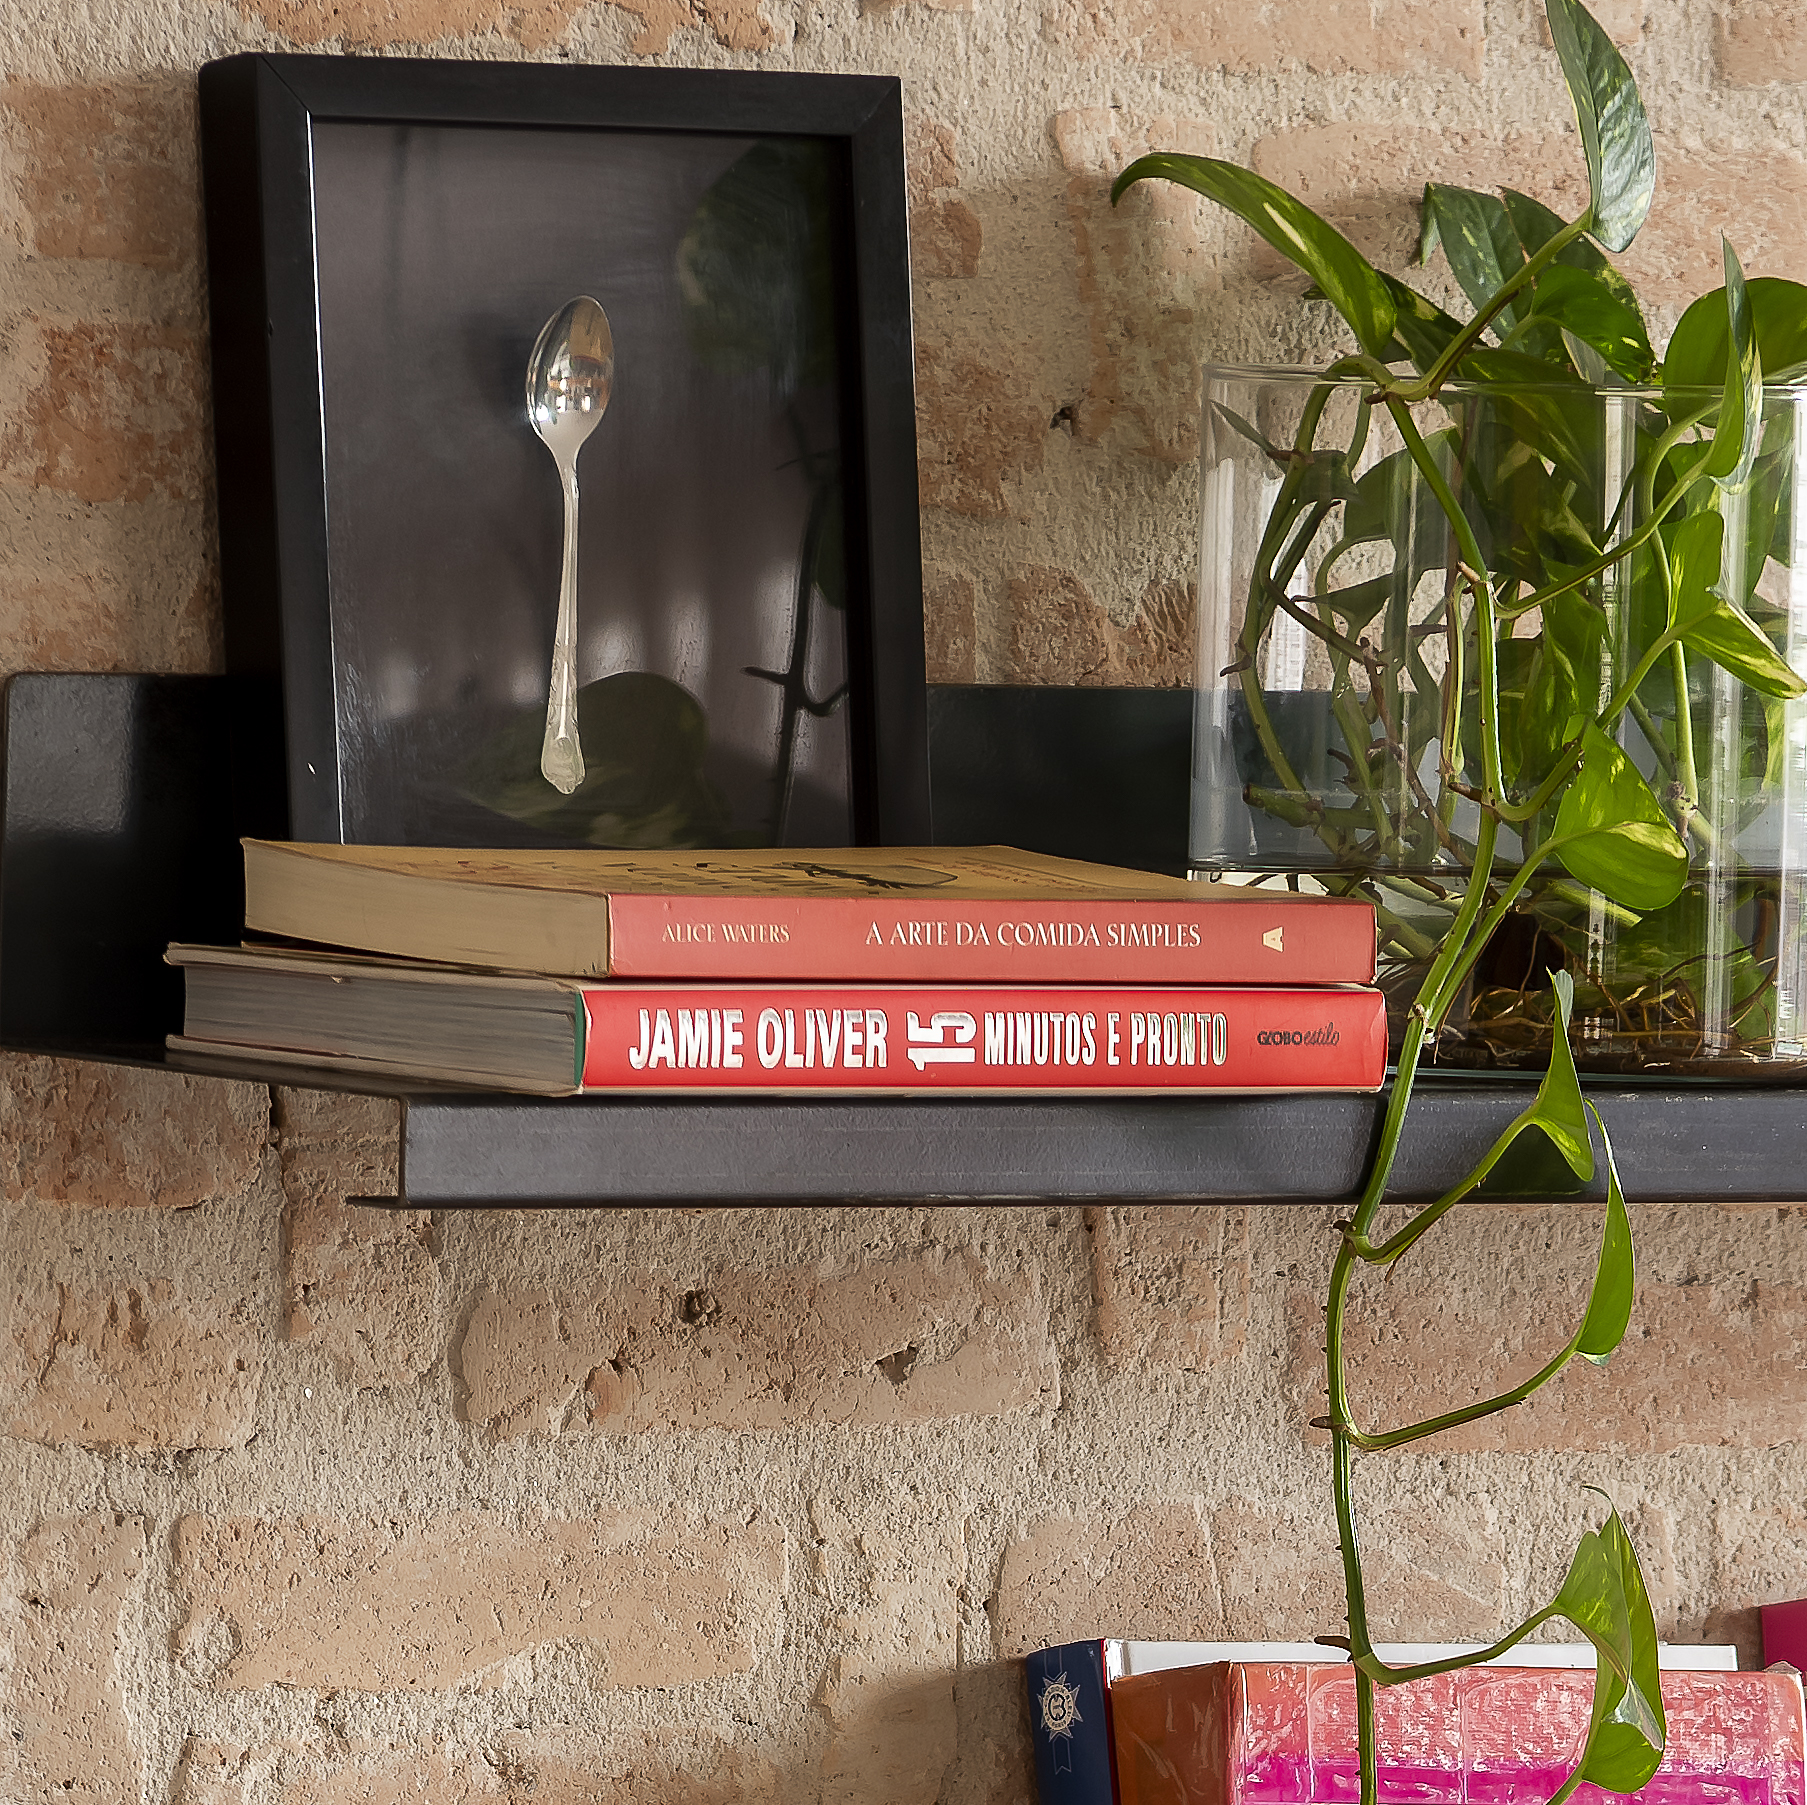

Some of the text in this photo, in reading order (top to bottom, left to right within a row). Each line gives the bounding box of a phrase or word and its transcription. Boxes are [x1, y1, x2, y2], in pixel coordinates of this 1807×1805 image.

[662, 923, 790, 944] ALICE WATERS
[866, 921, 1201, 948] A ARTE DA COMIDA SIMPLES
[629, 1007, 1228, 1071] JAMIE OLIVER 15 MINUTOS E PRONTO
